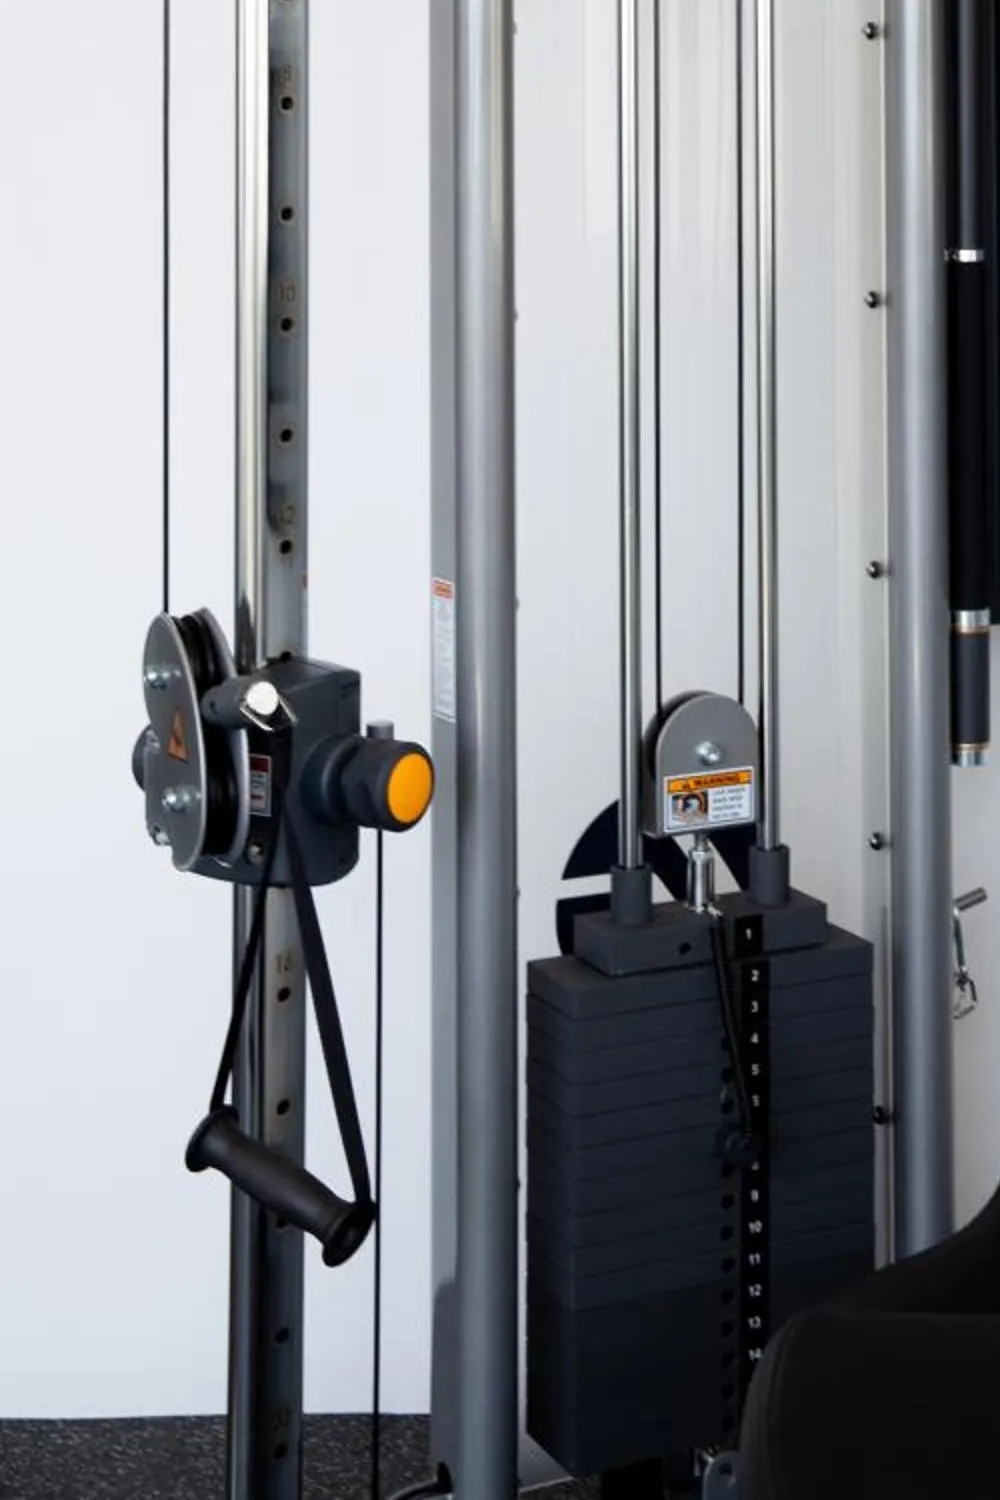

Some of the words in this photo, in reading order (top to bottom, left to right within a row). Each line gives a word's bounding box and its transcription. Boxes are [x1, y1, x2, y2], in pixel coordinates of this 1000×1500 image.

[745, 927, 752, 940] 1
[751, 969, 760, 982] 2
[751, 1000, 759, 1013] 3
[751, 1032, 760, 1044] 4
[751, 1063, 760, 1076] 5
[749, 1220, 762, 1233] 10
[749, 1252, 761, 1265] 11
[749, 1284, 762, 1297] 12
[748, 1315, 761, 1328] 13
